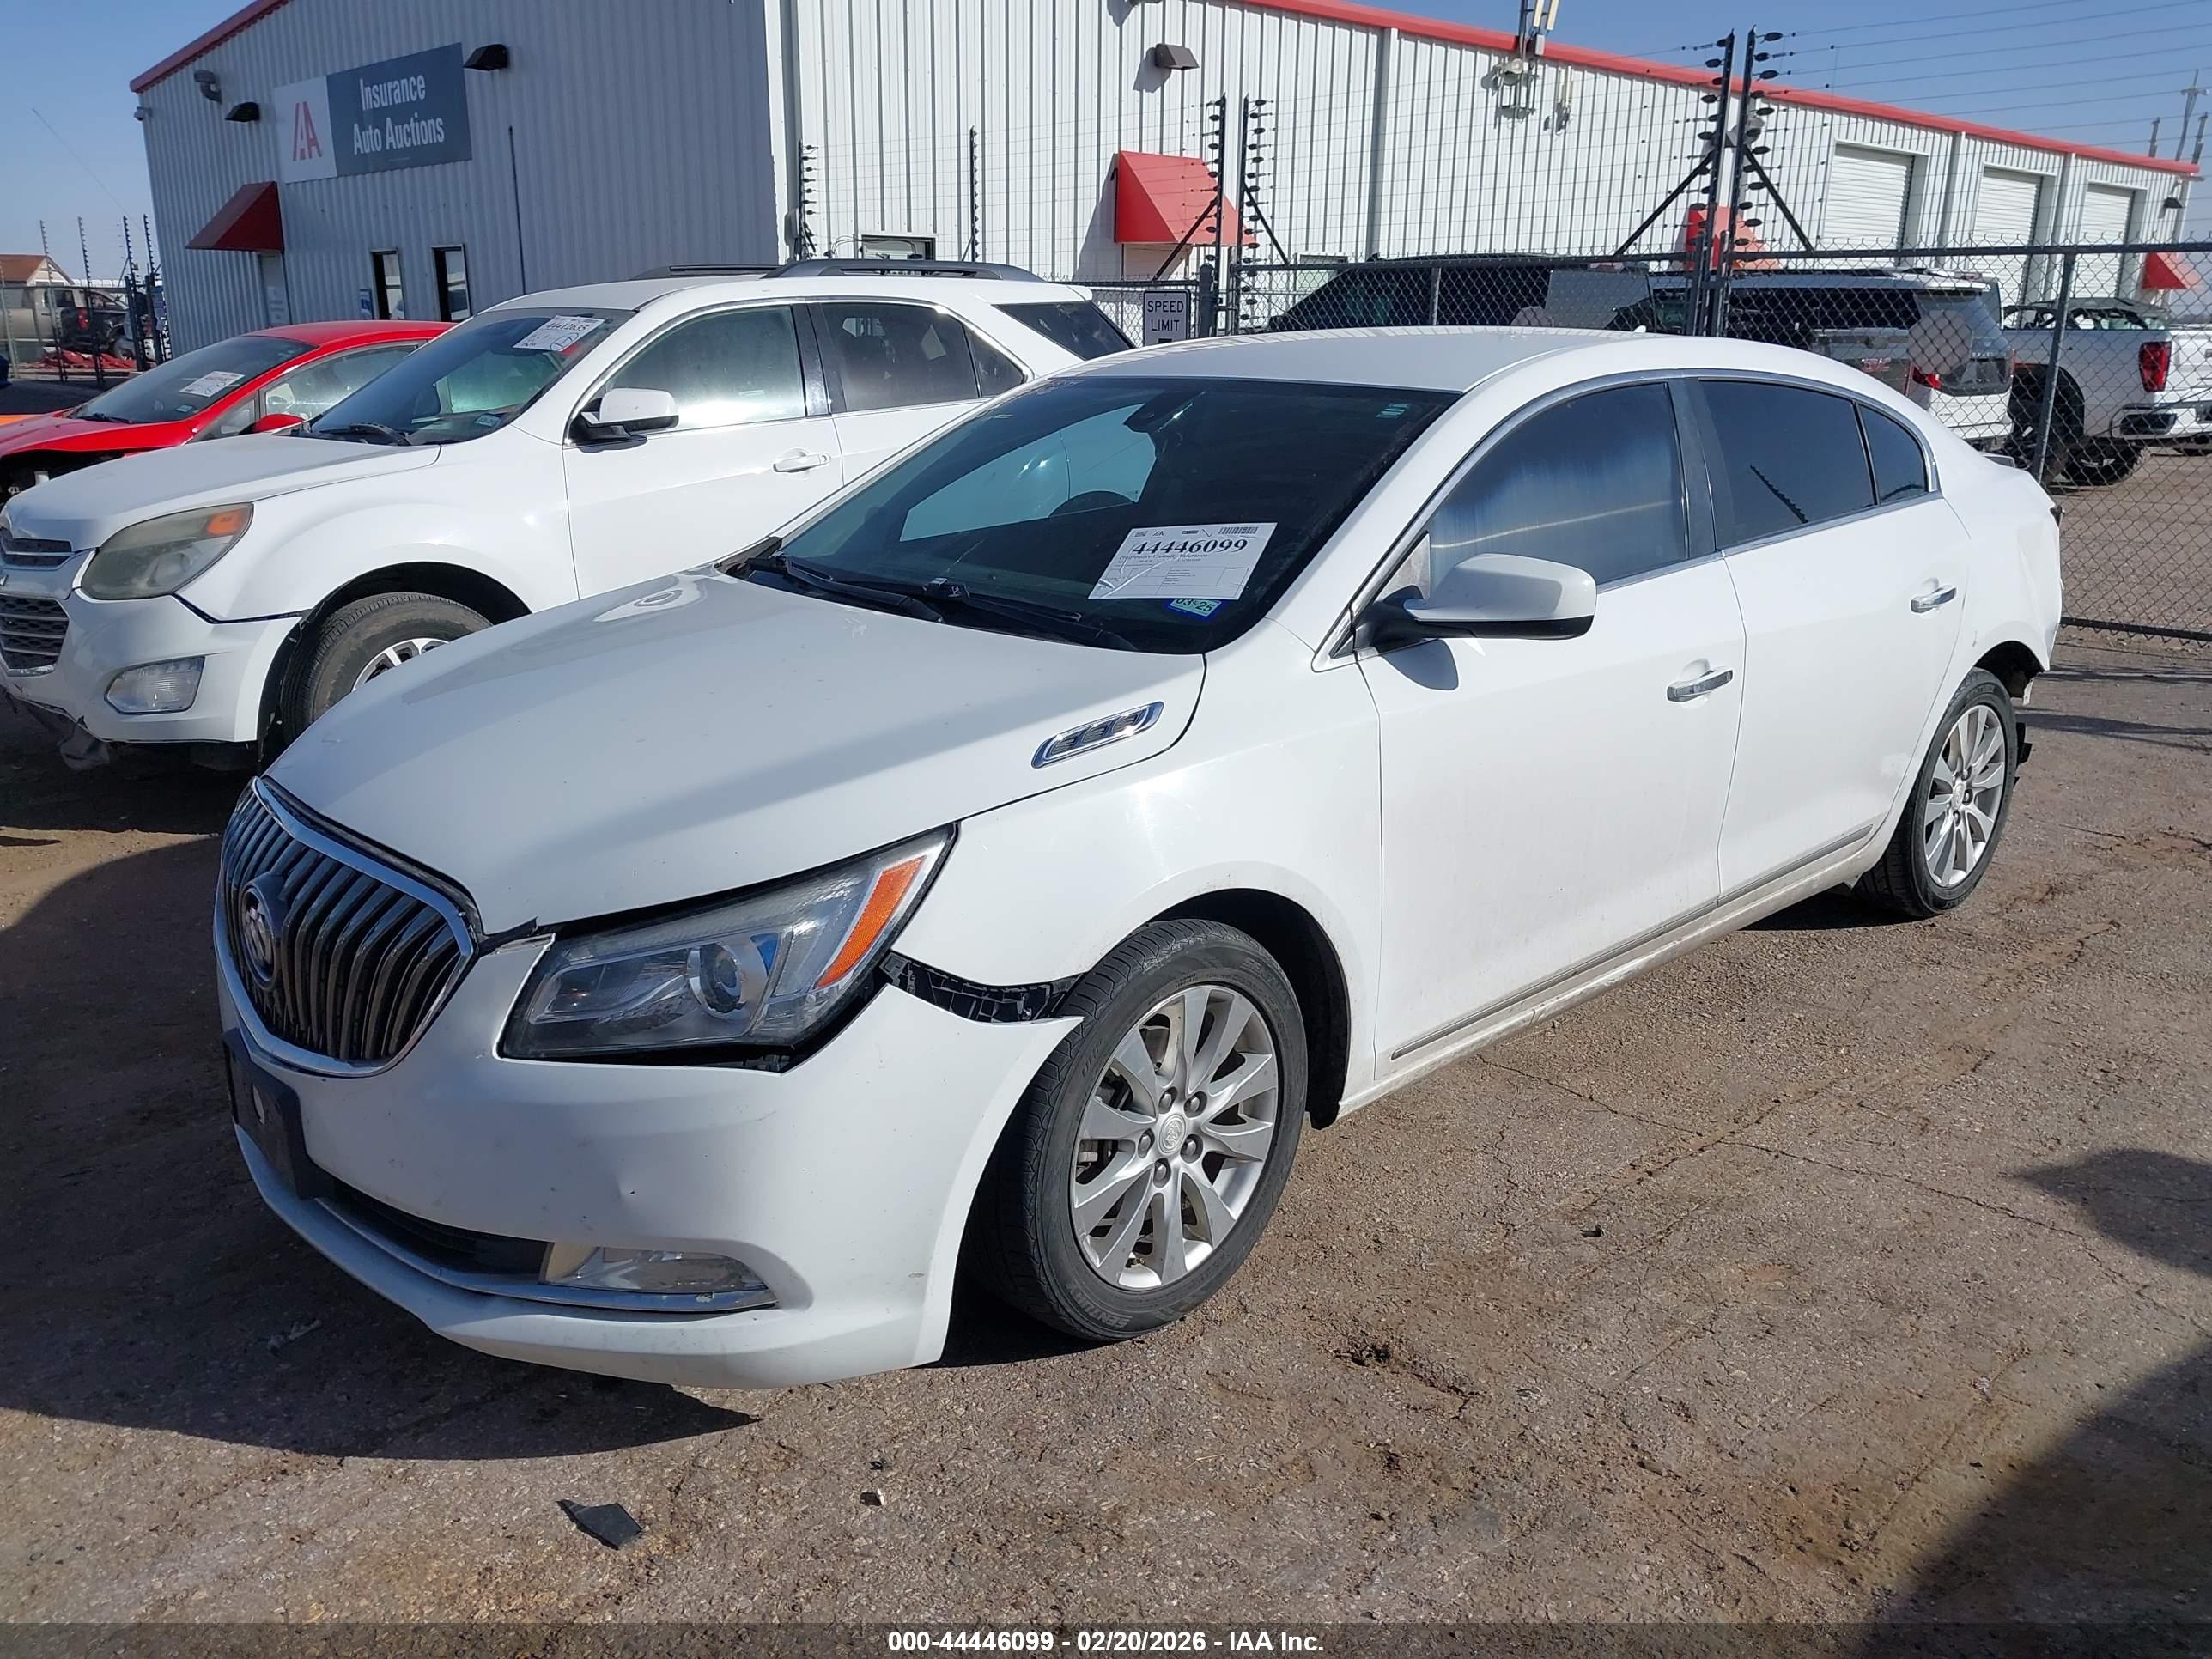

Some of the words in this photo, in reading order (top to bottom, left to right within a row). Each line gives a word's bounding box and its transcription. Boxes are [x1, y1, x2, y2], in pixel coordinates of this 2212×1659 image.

[359, 74, 426, 111] Insurance
[353, 123, 382, 155] Auto
[386, 112, 445, 150] Auctions
[1147, 301, 1184, 313] SPEED
[1151, 319, 1180, 331] LIMIT
[1131, 538, 1248, 555] 44446099
